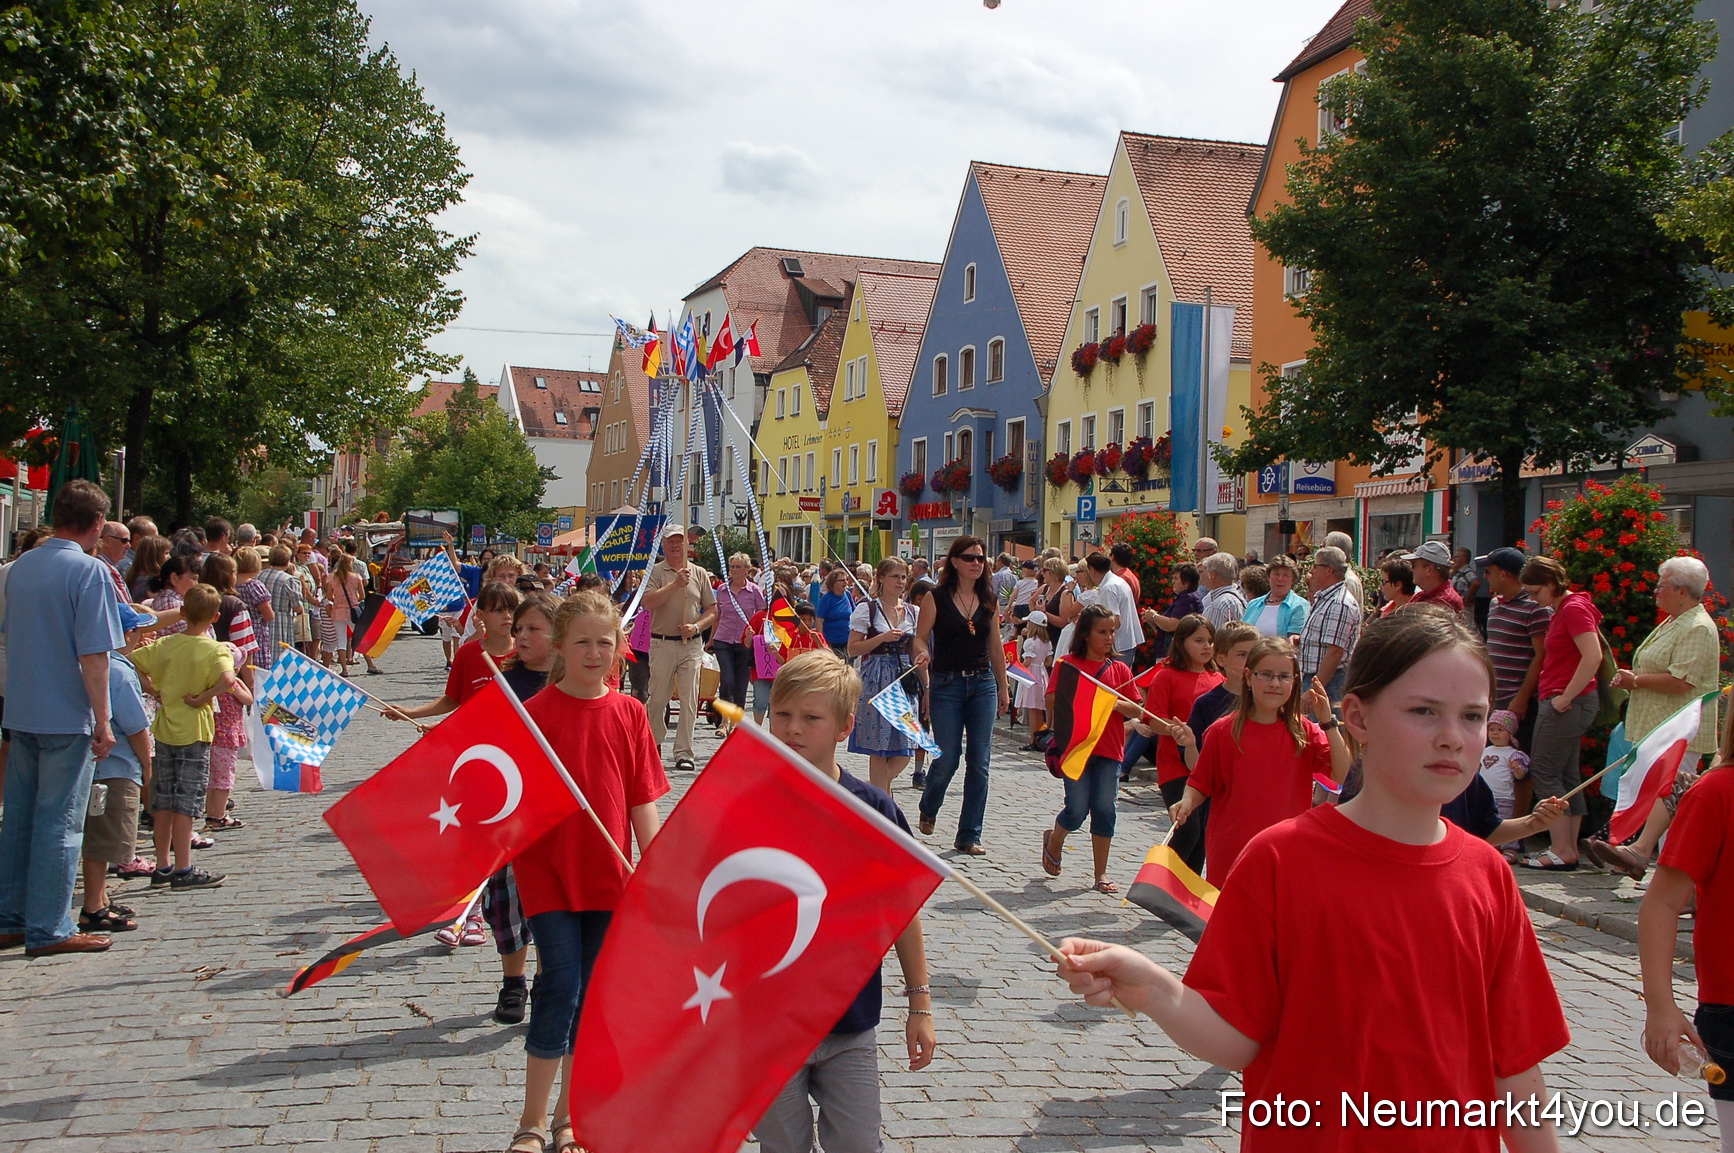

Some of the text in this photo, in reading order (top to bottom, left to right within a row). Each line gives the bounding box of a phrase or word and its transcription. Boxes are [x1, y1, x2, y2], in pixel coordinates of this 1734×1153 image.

[783, 435, 800, 450] HOTEL
[1296, 483, 1332, 492] Reisebüro
[1081, 499, 1092, 519] P
[608, 524, 634, 539] RUND
